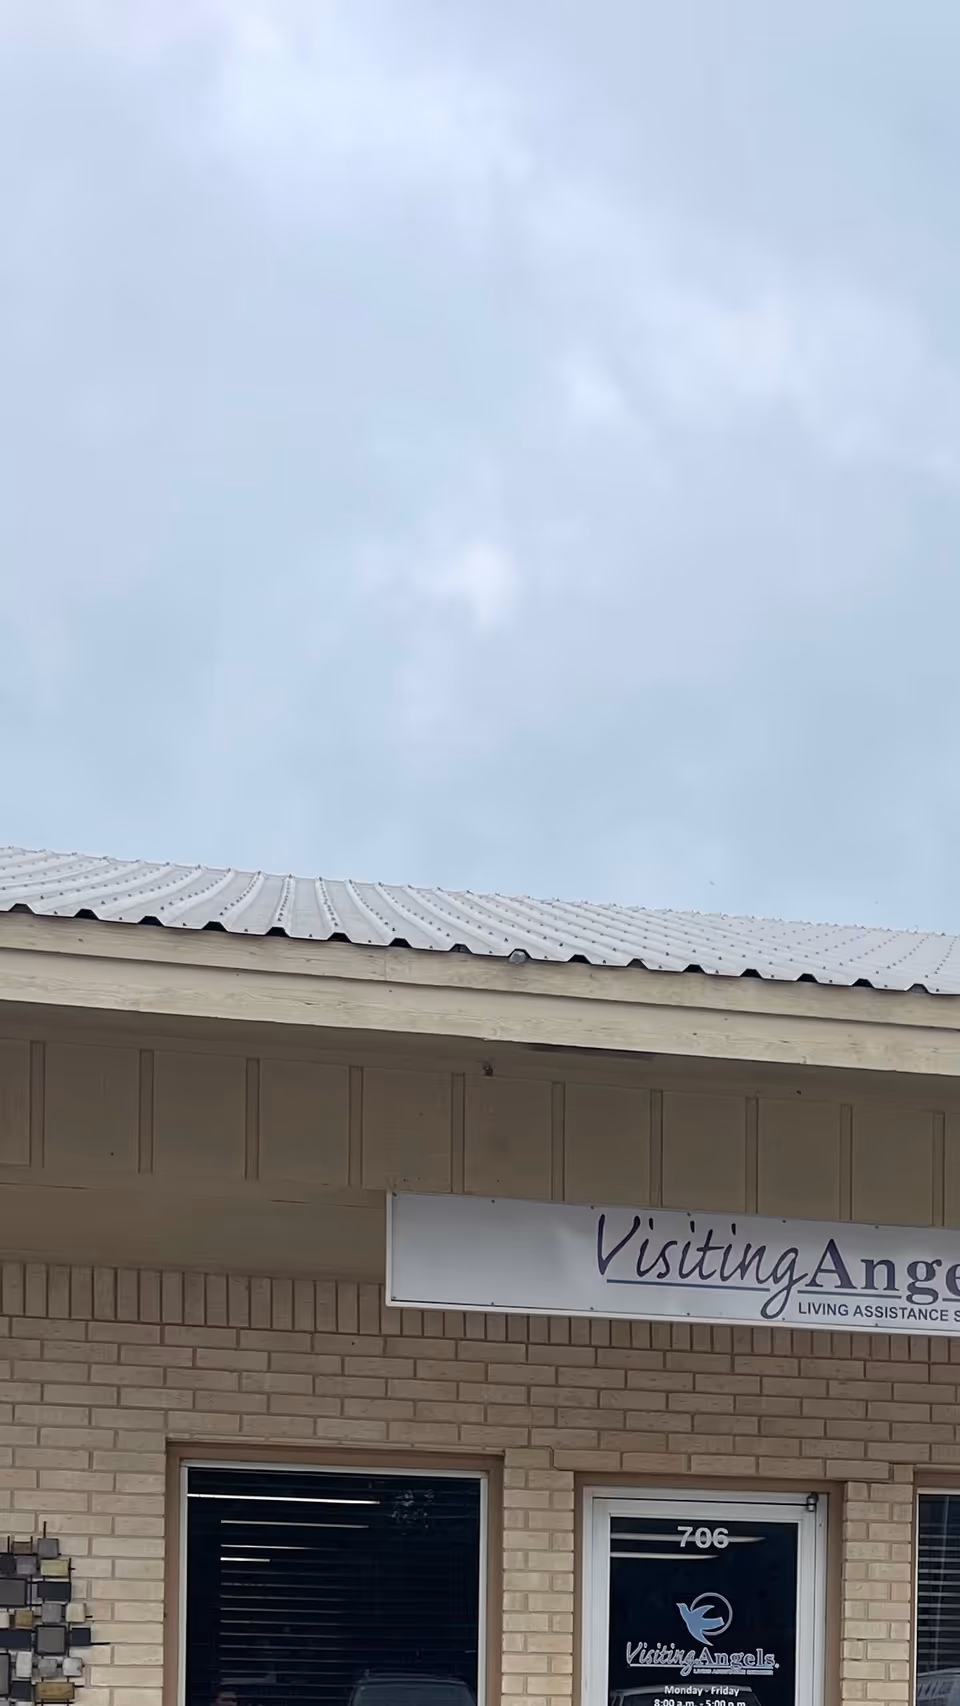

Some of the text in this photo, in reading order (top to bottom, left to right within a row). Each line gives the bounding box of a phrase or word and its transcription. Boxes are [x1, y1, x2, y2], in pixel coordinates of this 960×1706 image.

[597, 1214, 808, 1319] Visiting
[798, 1301, 849, 1317] LIVING
[852, 1304, 949, 1322] ASSISTANCE
[677, 1526, 730, 1549] 706
[626, 1641, 700, 1677] Visiting
[664, 1686, 703, 1696] Monday
[710, 1686, 740, 1696] Friday
